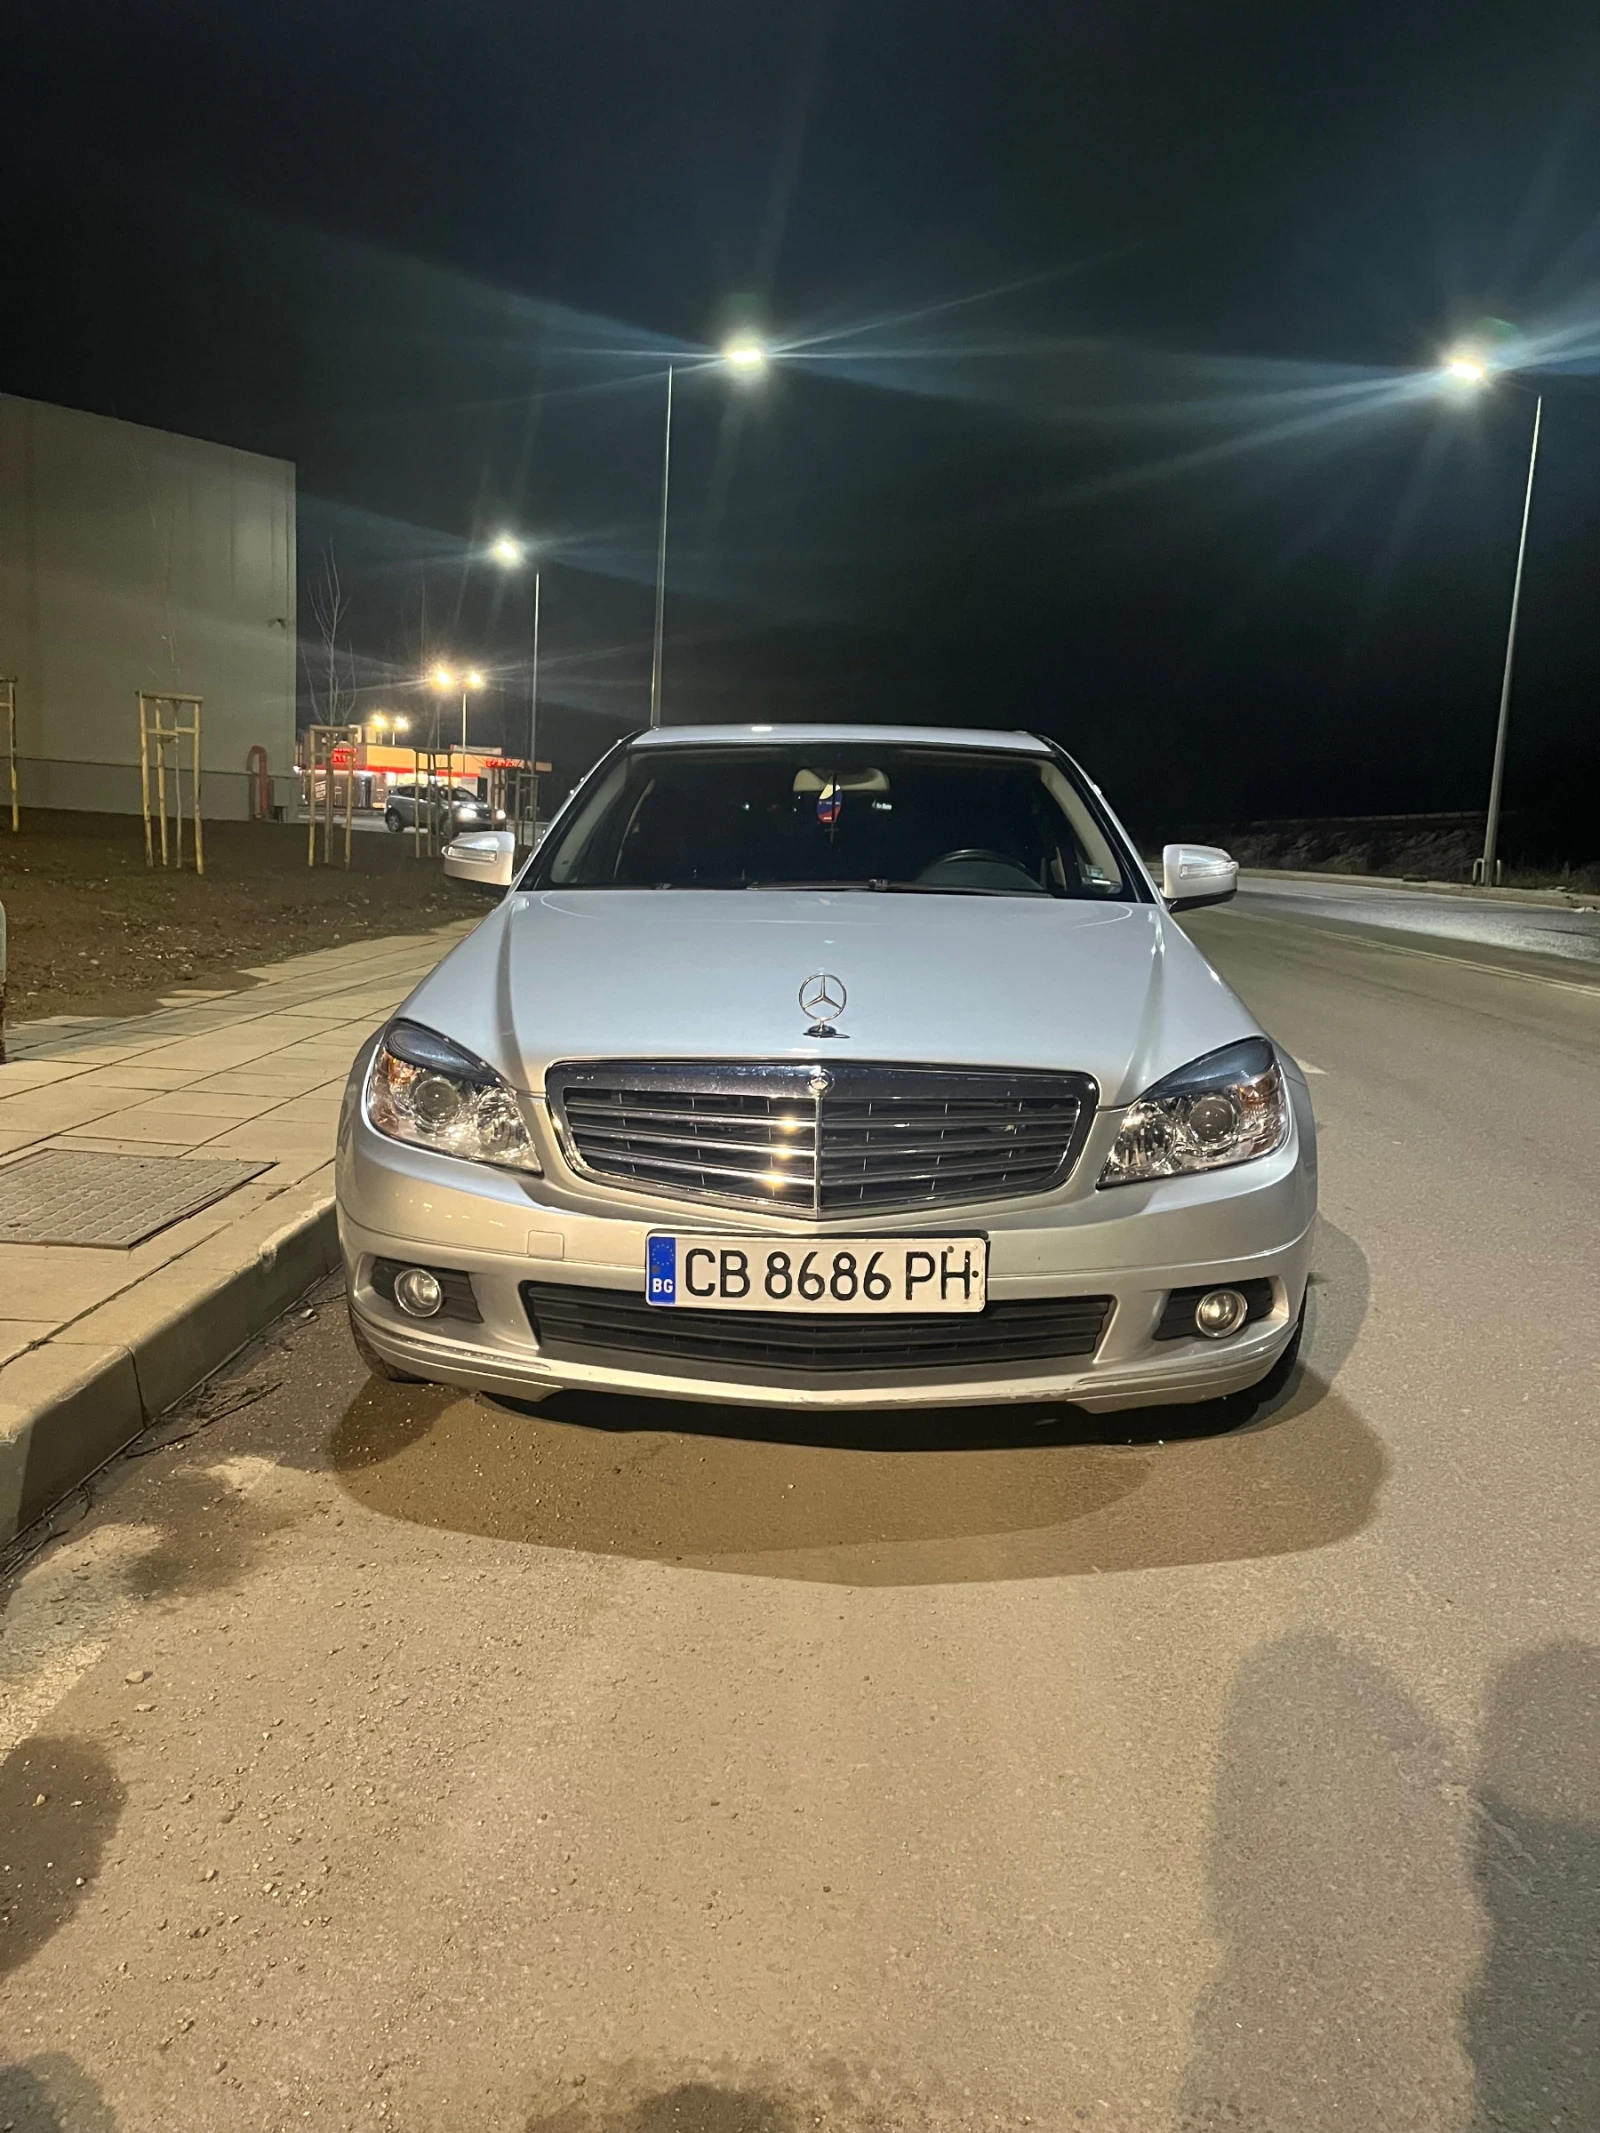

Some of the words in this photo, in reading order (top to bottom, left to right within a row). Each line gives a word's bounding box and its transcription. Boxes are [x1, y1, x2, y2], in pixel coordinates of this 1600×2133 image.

[652, 1277, 674, 1293] BG
[685, 1248, 750, 1298] CB
[764, 1251, 892, 1301] 8686
[905, 1250, 971, 1301] PH
